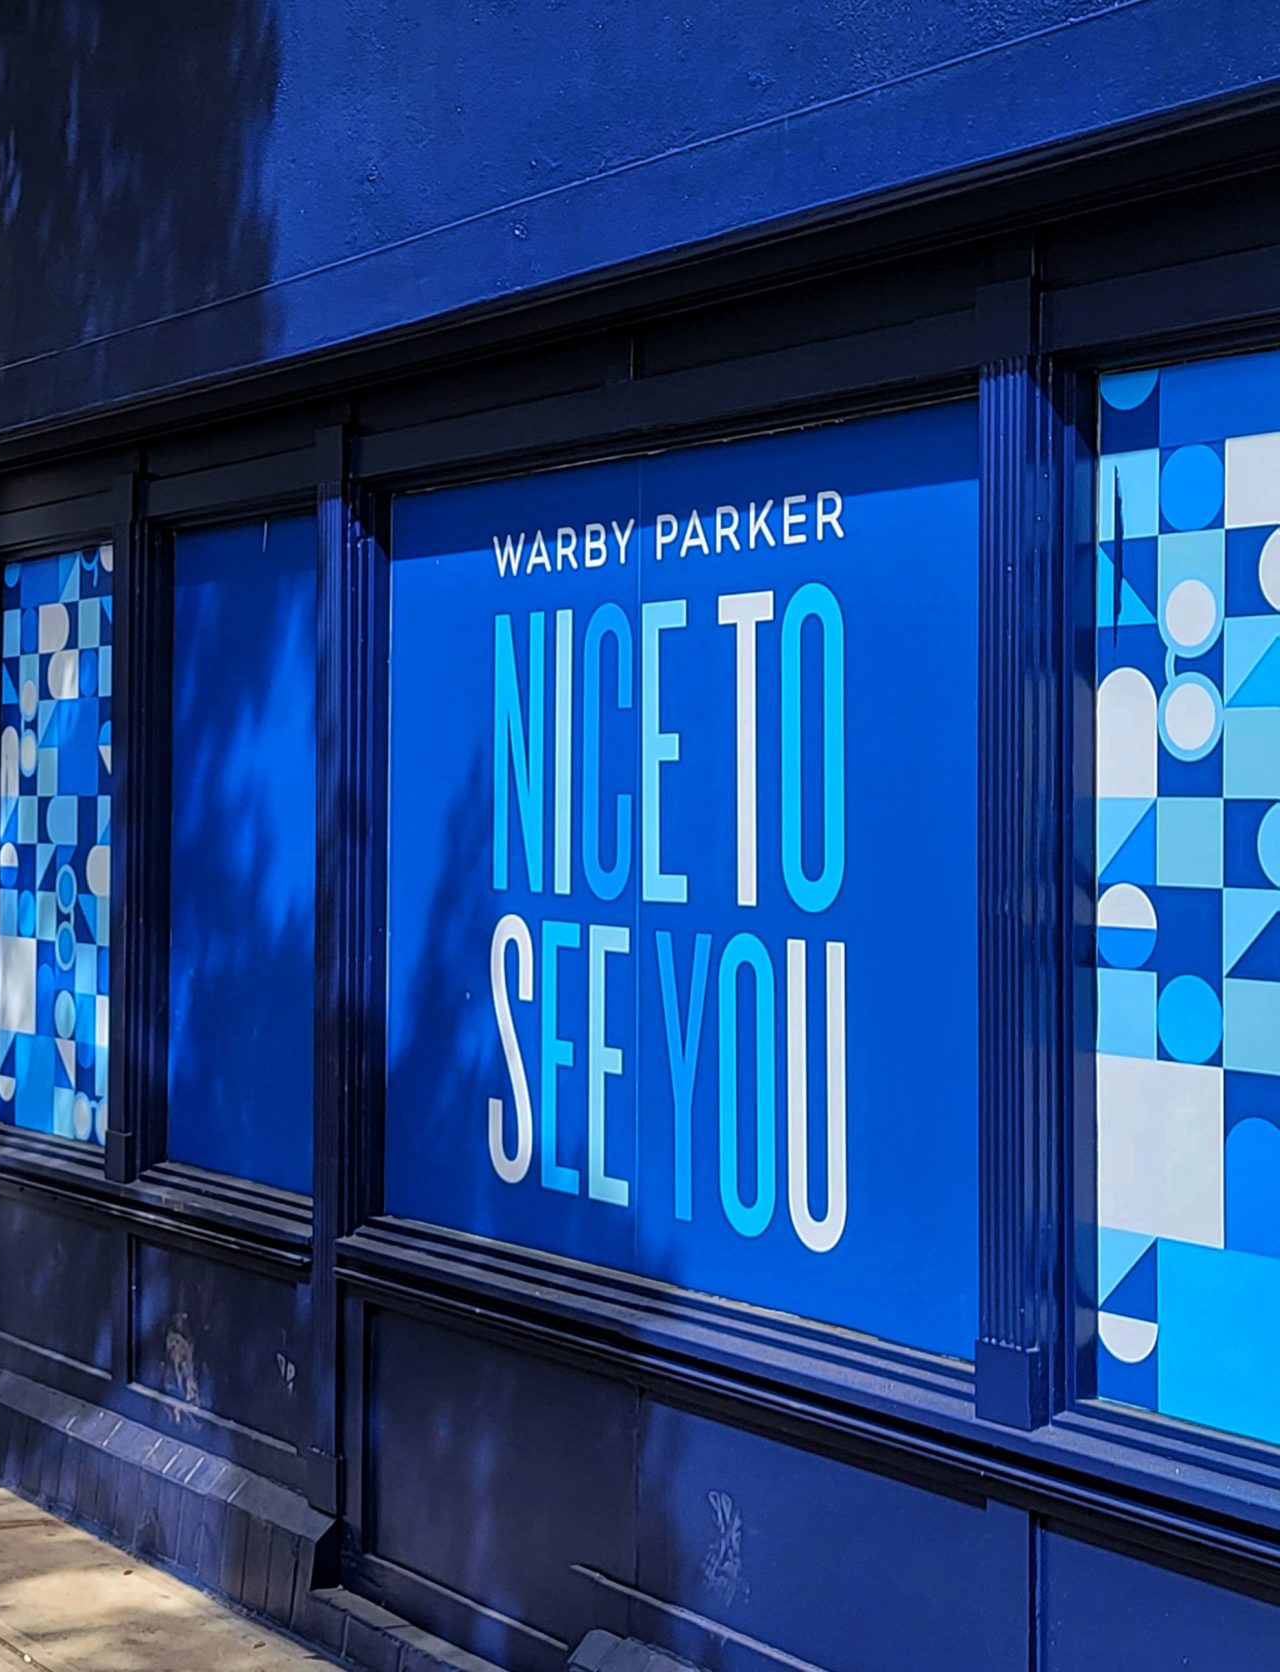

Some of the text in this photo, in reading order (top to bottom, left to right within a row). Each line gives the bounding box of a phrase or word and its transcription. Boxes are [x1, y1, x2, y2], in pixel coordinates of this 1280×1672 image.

[493, 490, 845, 578] WARBY PARKER
[492, 582, 845, 913] NICE TO
[488, 914, 846, 1252] SEE YOU
